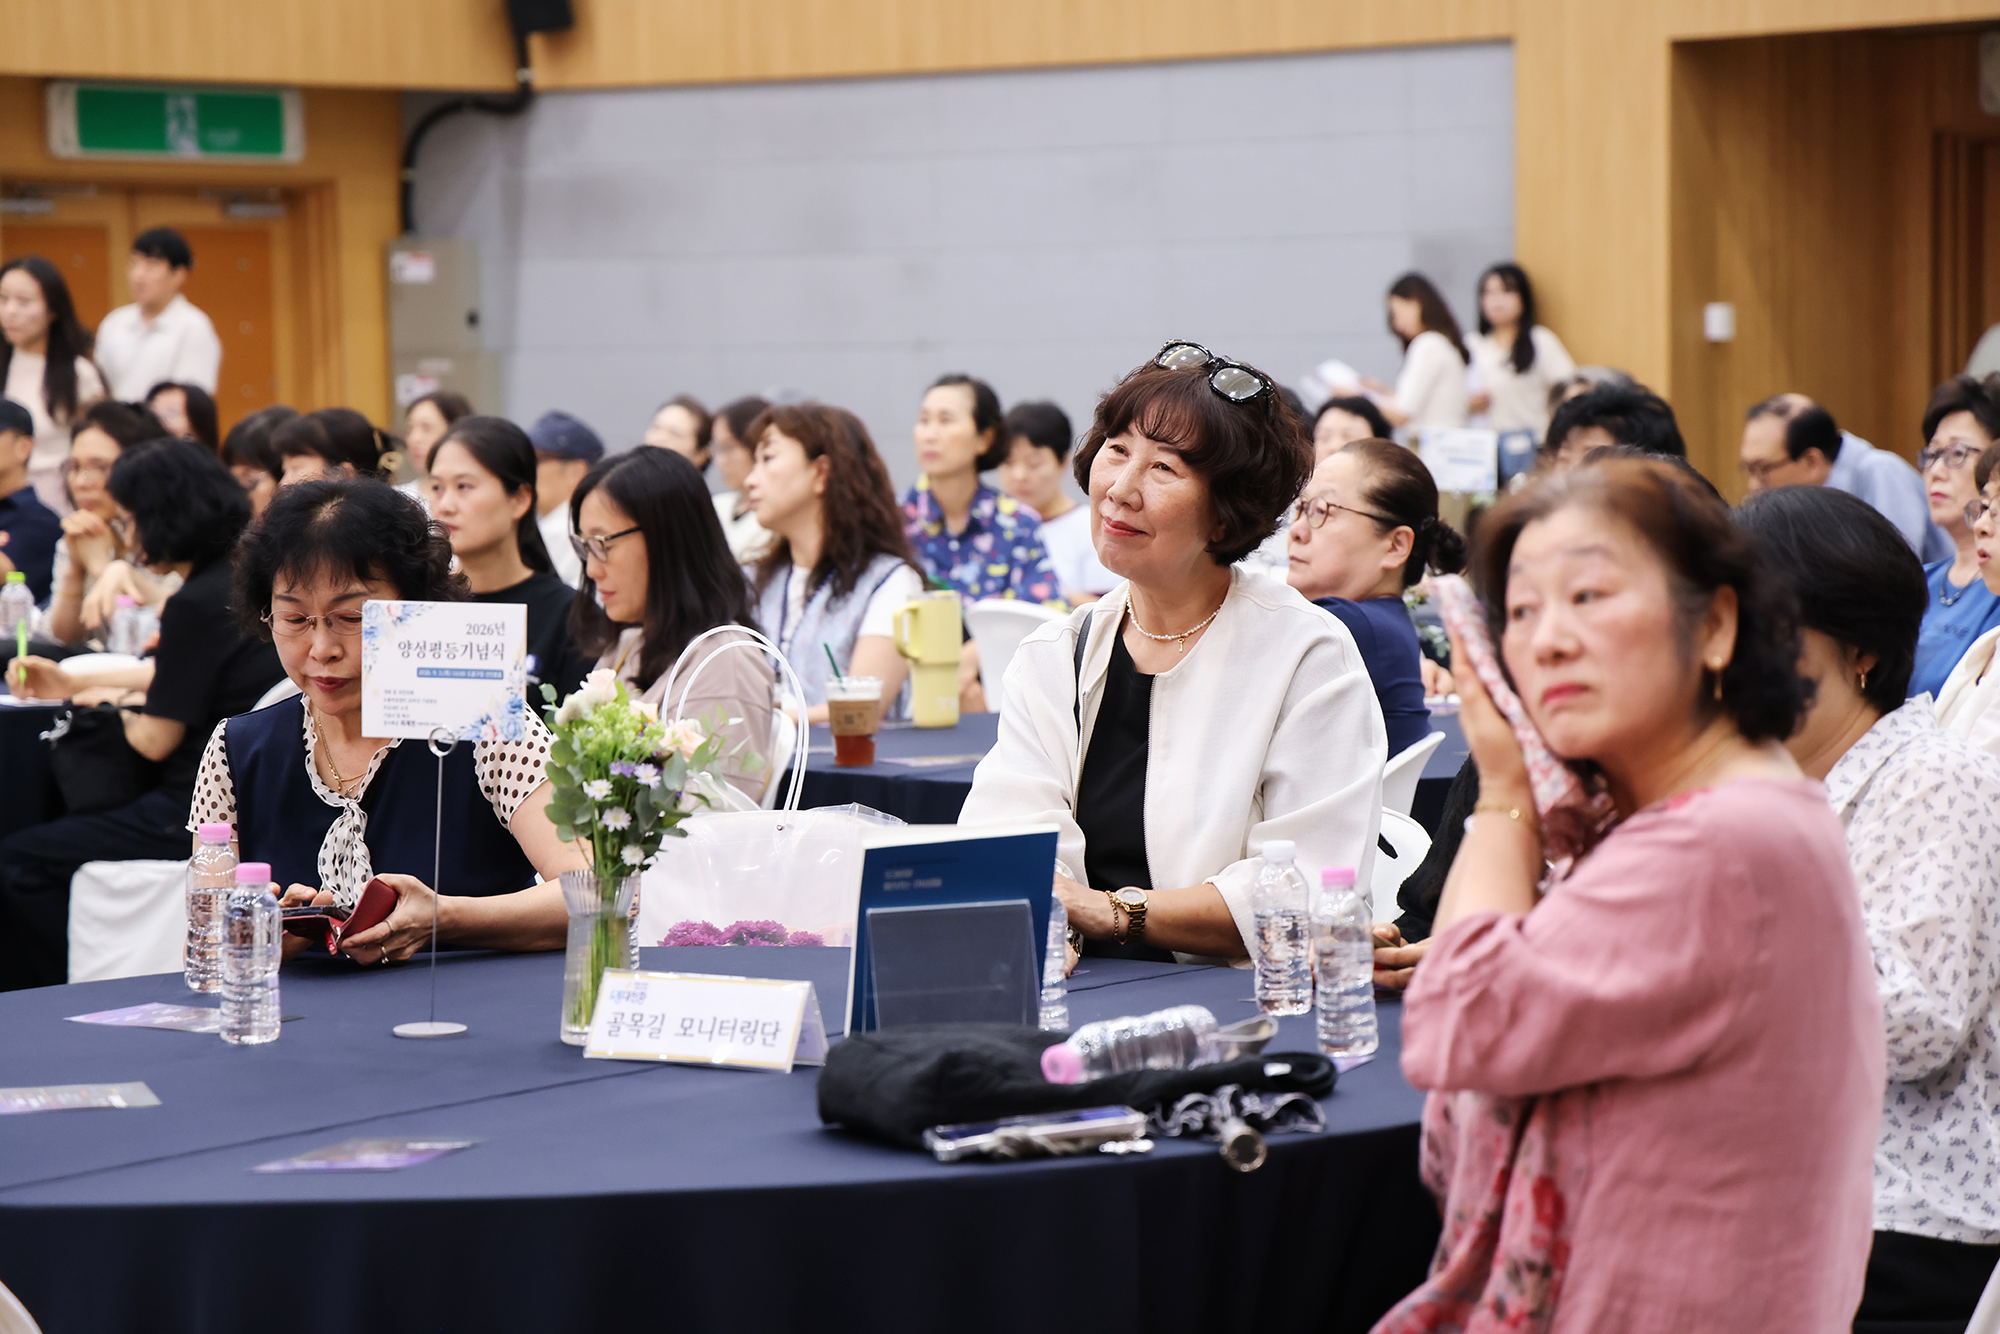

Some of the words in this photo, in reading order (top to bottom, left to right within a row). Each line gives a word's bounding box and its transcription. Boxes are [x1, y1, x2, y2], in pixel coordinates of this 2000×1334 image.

[465, 621, 506, 637] 2026년
[398, 639, 505, 661] 양성평등기념식
[606, 1010, 666, 1040] 골목길
[674, 1015, 782, 1048] 모니터링단
